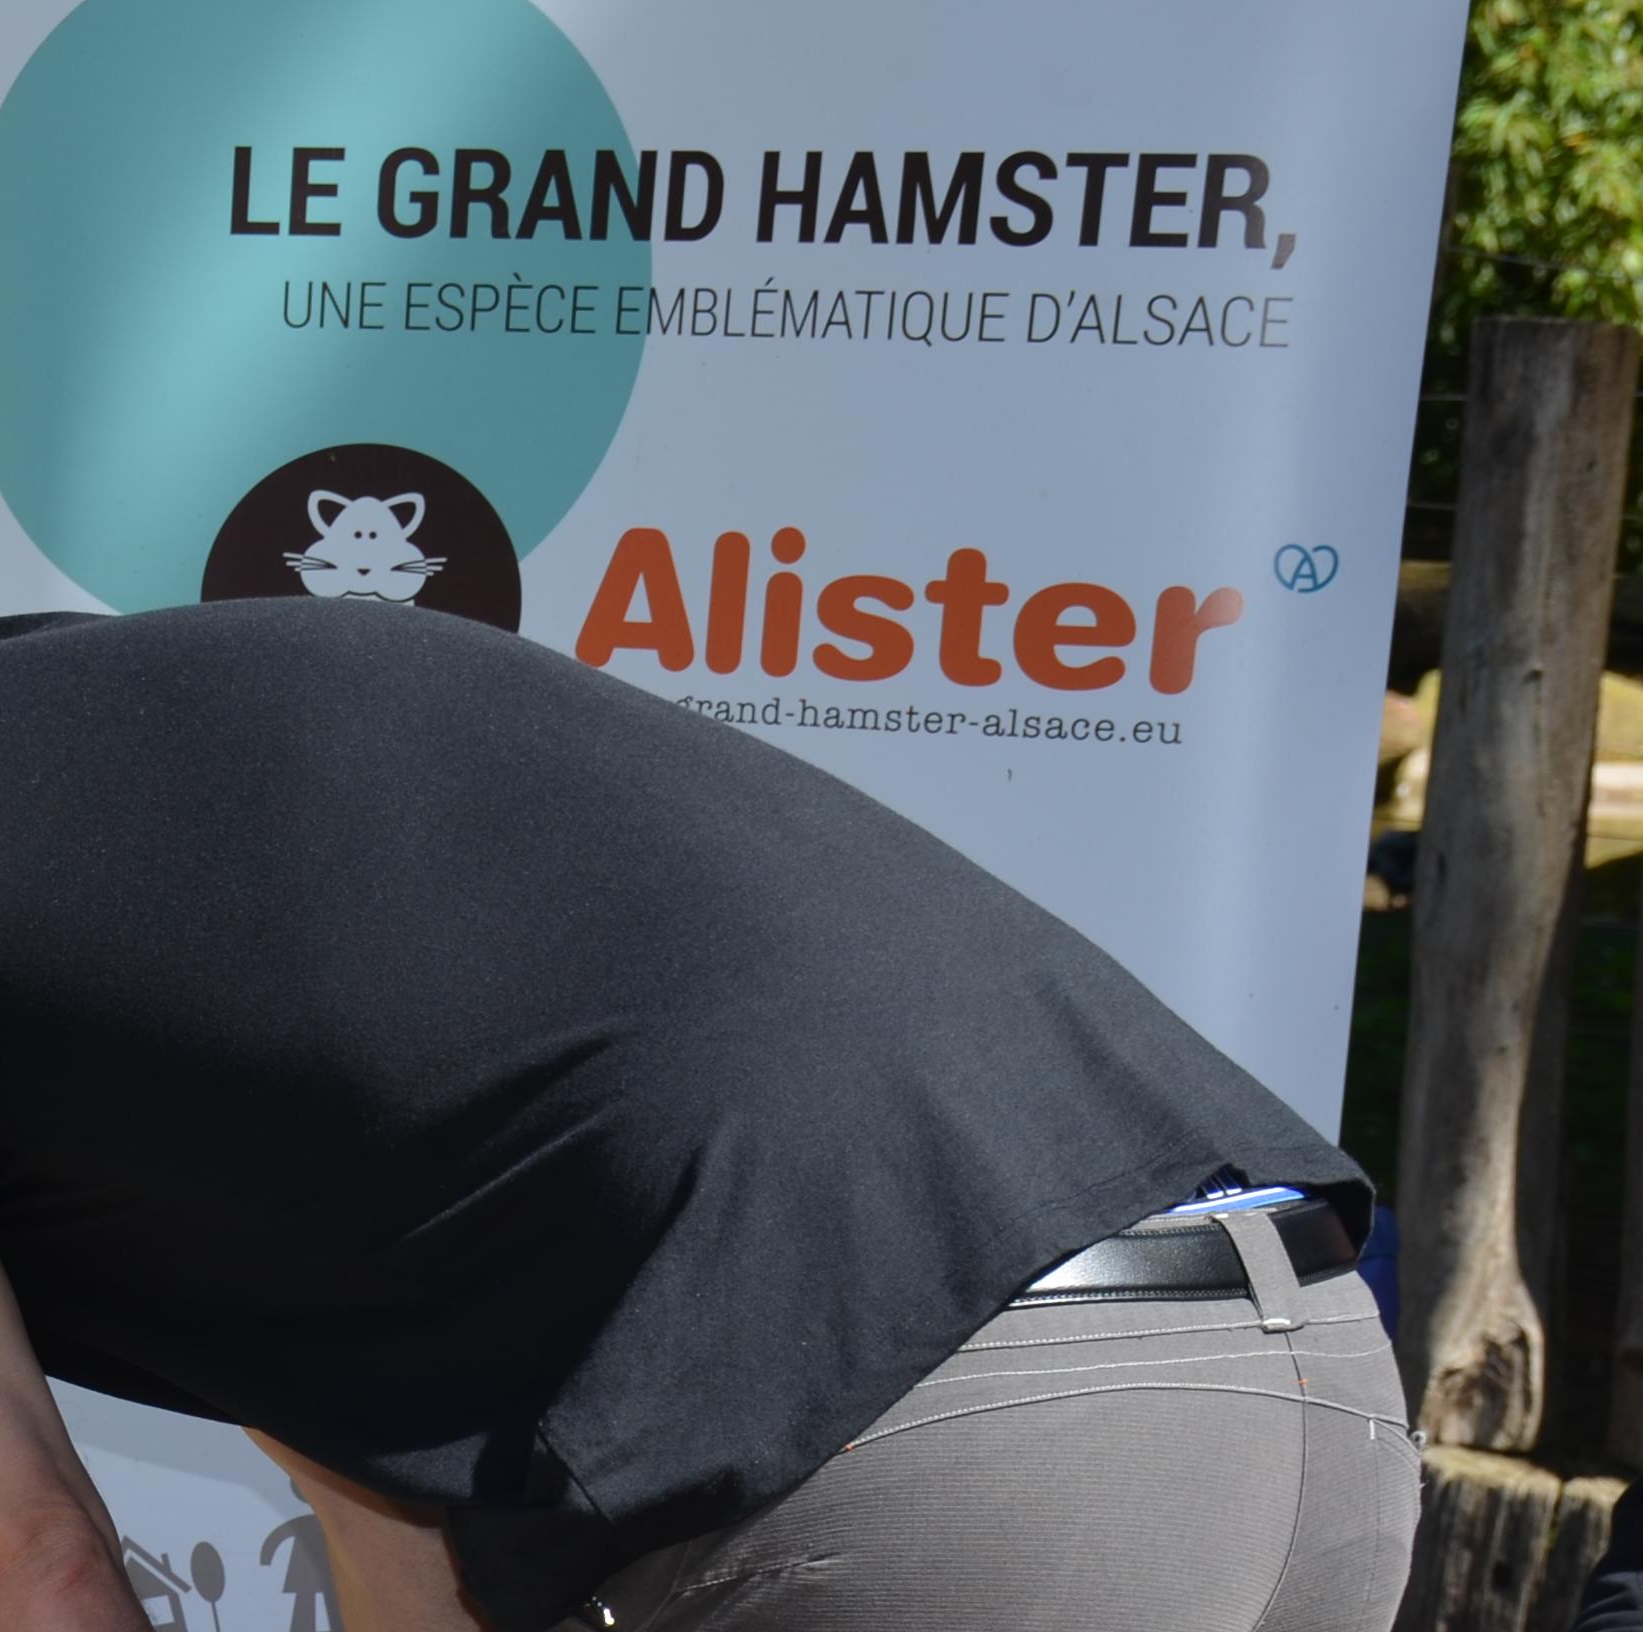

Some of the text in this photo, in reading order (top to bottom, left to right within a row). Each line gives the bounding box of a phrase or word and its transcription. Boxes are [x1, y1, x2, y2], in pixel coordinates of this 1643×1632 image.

[227, 145, 1297, 270] LE GRAND HAMSTER,
[281, 271, 1295, 349] UNE ESPÈCE EMBLÉMATIQUE D'ALSACE
[575, 526, 1246, 696] Alister
